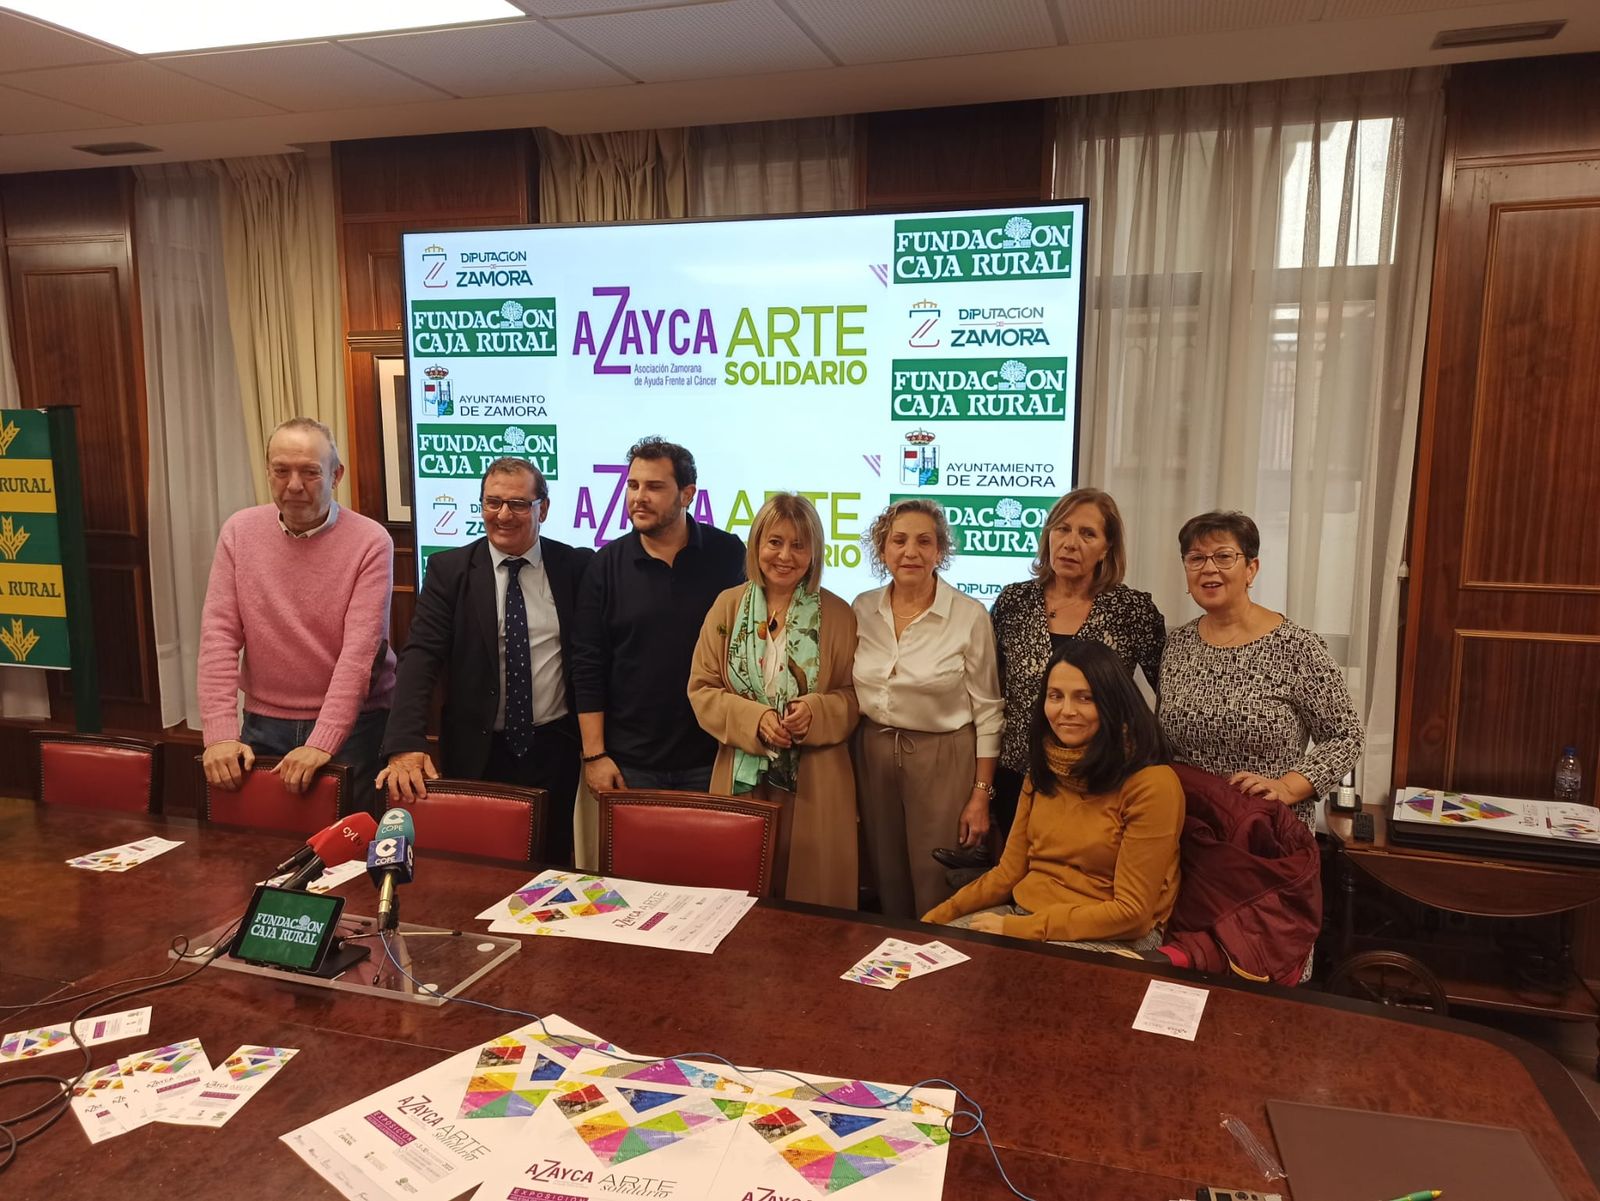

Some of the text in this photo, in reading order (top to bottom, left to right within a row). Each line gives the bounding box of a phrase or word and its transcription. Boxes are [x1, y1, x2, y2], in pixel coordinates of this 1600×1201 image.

[896, 250, 1070, 279] CAJA RURAL
[456, 270, 533, 287] ZAMORA
[572, 286, 867, 374] AZAYCA ARTE
[951, 328, 1050, 347] ZAMORA
[415, 331, 555, 354] CAJA RURAL
[670, 363, 702, 373] Zamorana
[724, 360, 867, 385] SOLIDARIO
[634, 376, 643, 386] de
[644, 376, 664, 388] Ayuda
[665, 376, 685, 386] Frente
[686, 376, 693, 386] al
[459, 395, 546, 404] AYUNTAMIENTO
[893, 394, 1064, 418] CAJA RURAL
[460, 406, 547, 416] DE ZAMORA
[420, 454, 474, 476] CAJA
[946, 463, 1054, 473] AYUNTAMIENTO
[947, 475, 1055, 487] DE ZAMORA
[573, 464, 861, 548] AZA ATE
[963, 529, 1040, 552] RURA
[8, 581, 61, 598] RURAL
[381, 825, 403, 834] COPE
[374, 856, 396, 866] COPE
[250, 924, 318, 946] CAJA RURAL
[396, 1095, 444, 1127] AZAYCA
[525, 1159, 678, 1194] AZAYCA ARTE
